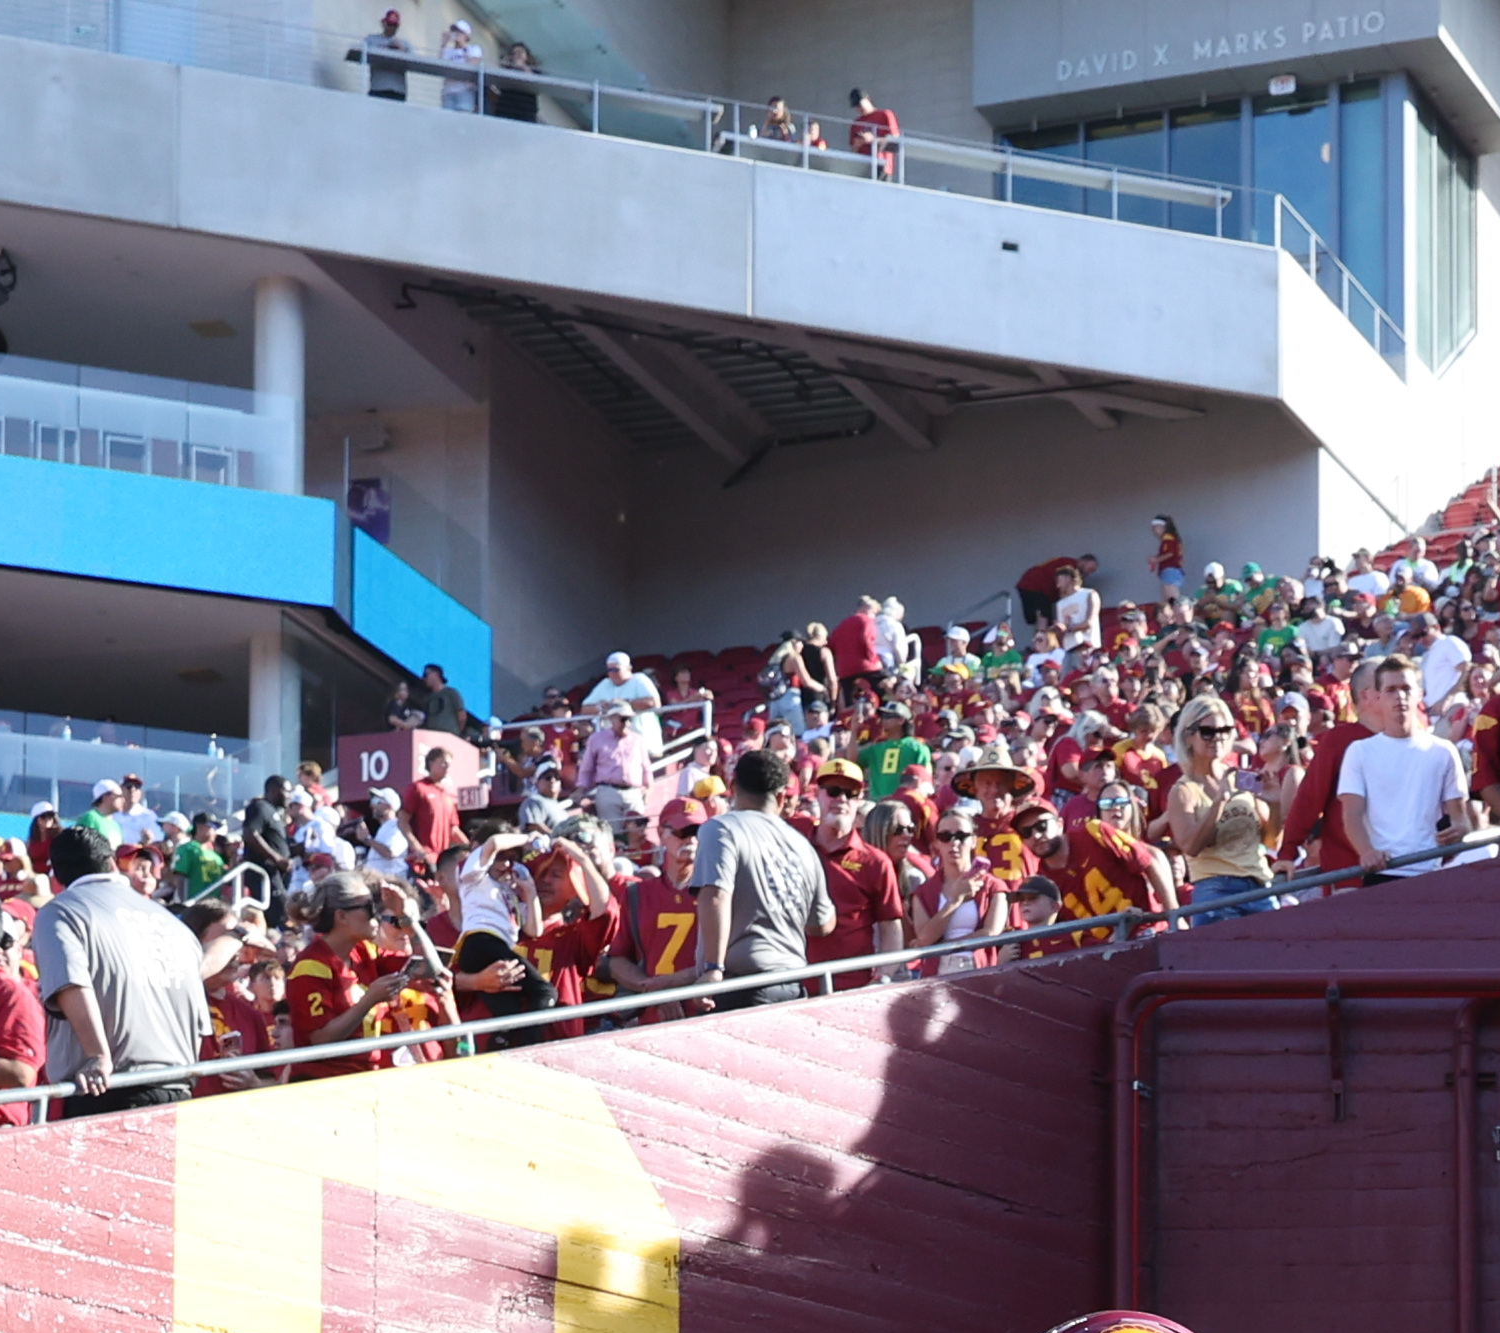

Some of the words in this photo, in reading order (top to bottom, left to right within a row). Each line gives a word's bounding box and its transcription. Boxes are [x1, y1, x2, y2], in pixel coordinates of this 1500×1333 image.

[1056, 50, 1138, 83] DAVID
[1192, 26, 1288, 62] MARKS
[1301, 10, 1386, 46] PATIO
[359, 751, 389, 783] 10
[881, 748, 900, 775] 8
[655, 912, 696, 976] 7
[308, 992, 324, 1017] 2
